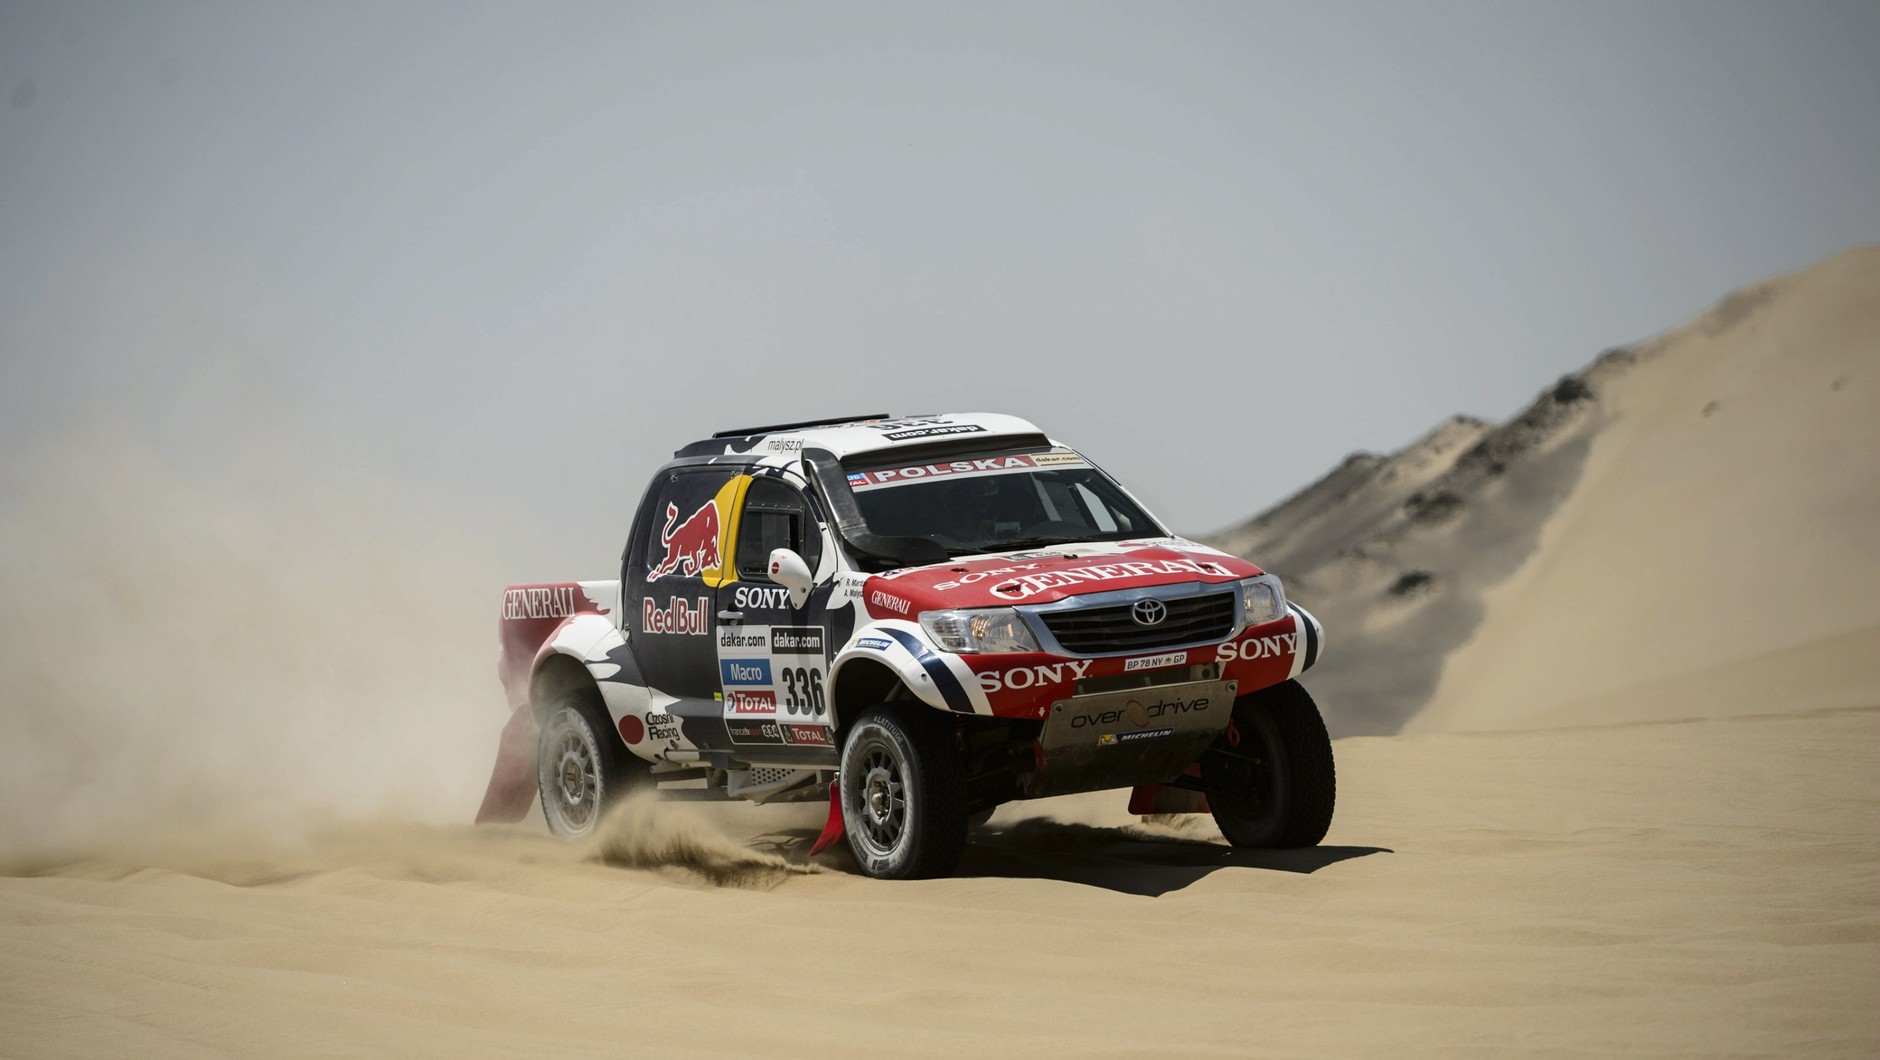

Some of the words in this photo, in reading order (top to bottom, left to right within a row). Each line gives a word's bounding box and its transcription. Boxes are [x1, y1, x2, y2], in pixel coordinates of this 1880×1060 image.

[890, 425, 979, 440] dakar.com
[767, 438, 805, 454] malysz.pl
[872, 456, 1029, 482] POLSKA
[932, 562, 1040, 591] SONY
[989, 559, 1240, 600] GENERALI
[502, 587, 576, 620] GENERALI
[734, 586, 791, 610] SONY
[871, 590, 911, 615] GENERALI
[642, 596, 676, 634] Red
[676, 596, 710, 636] Bull
[720, 632, 766, 648] dakar.com
[773, 632, 821, 648] dakar.com
[1213, 632, 1299, 663] SONY
[730, 663, 763, 681] Macro
[1127, 660, 1139, 670] BP
[1140, 659, 1151, 668] 78
[1151, 657, 1164, 667] NY
[1173, 654, 1185, 664] GP
[976, 660, 1094, 693] SONY
[781, 666, 827, 716] 336
[736, 693, 776, 711] TOTAL
[648, 725, 681, 741] Racing
[791, 727, 826, 742] TOTAL
[1120, 730, 1173, 741] MICHELIN
